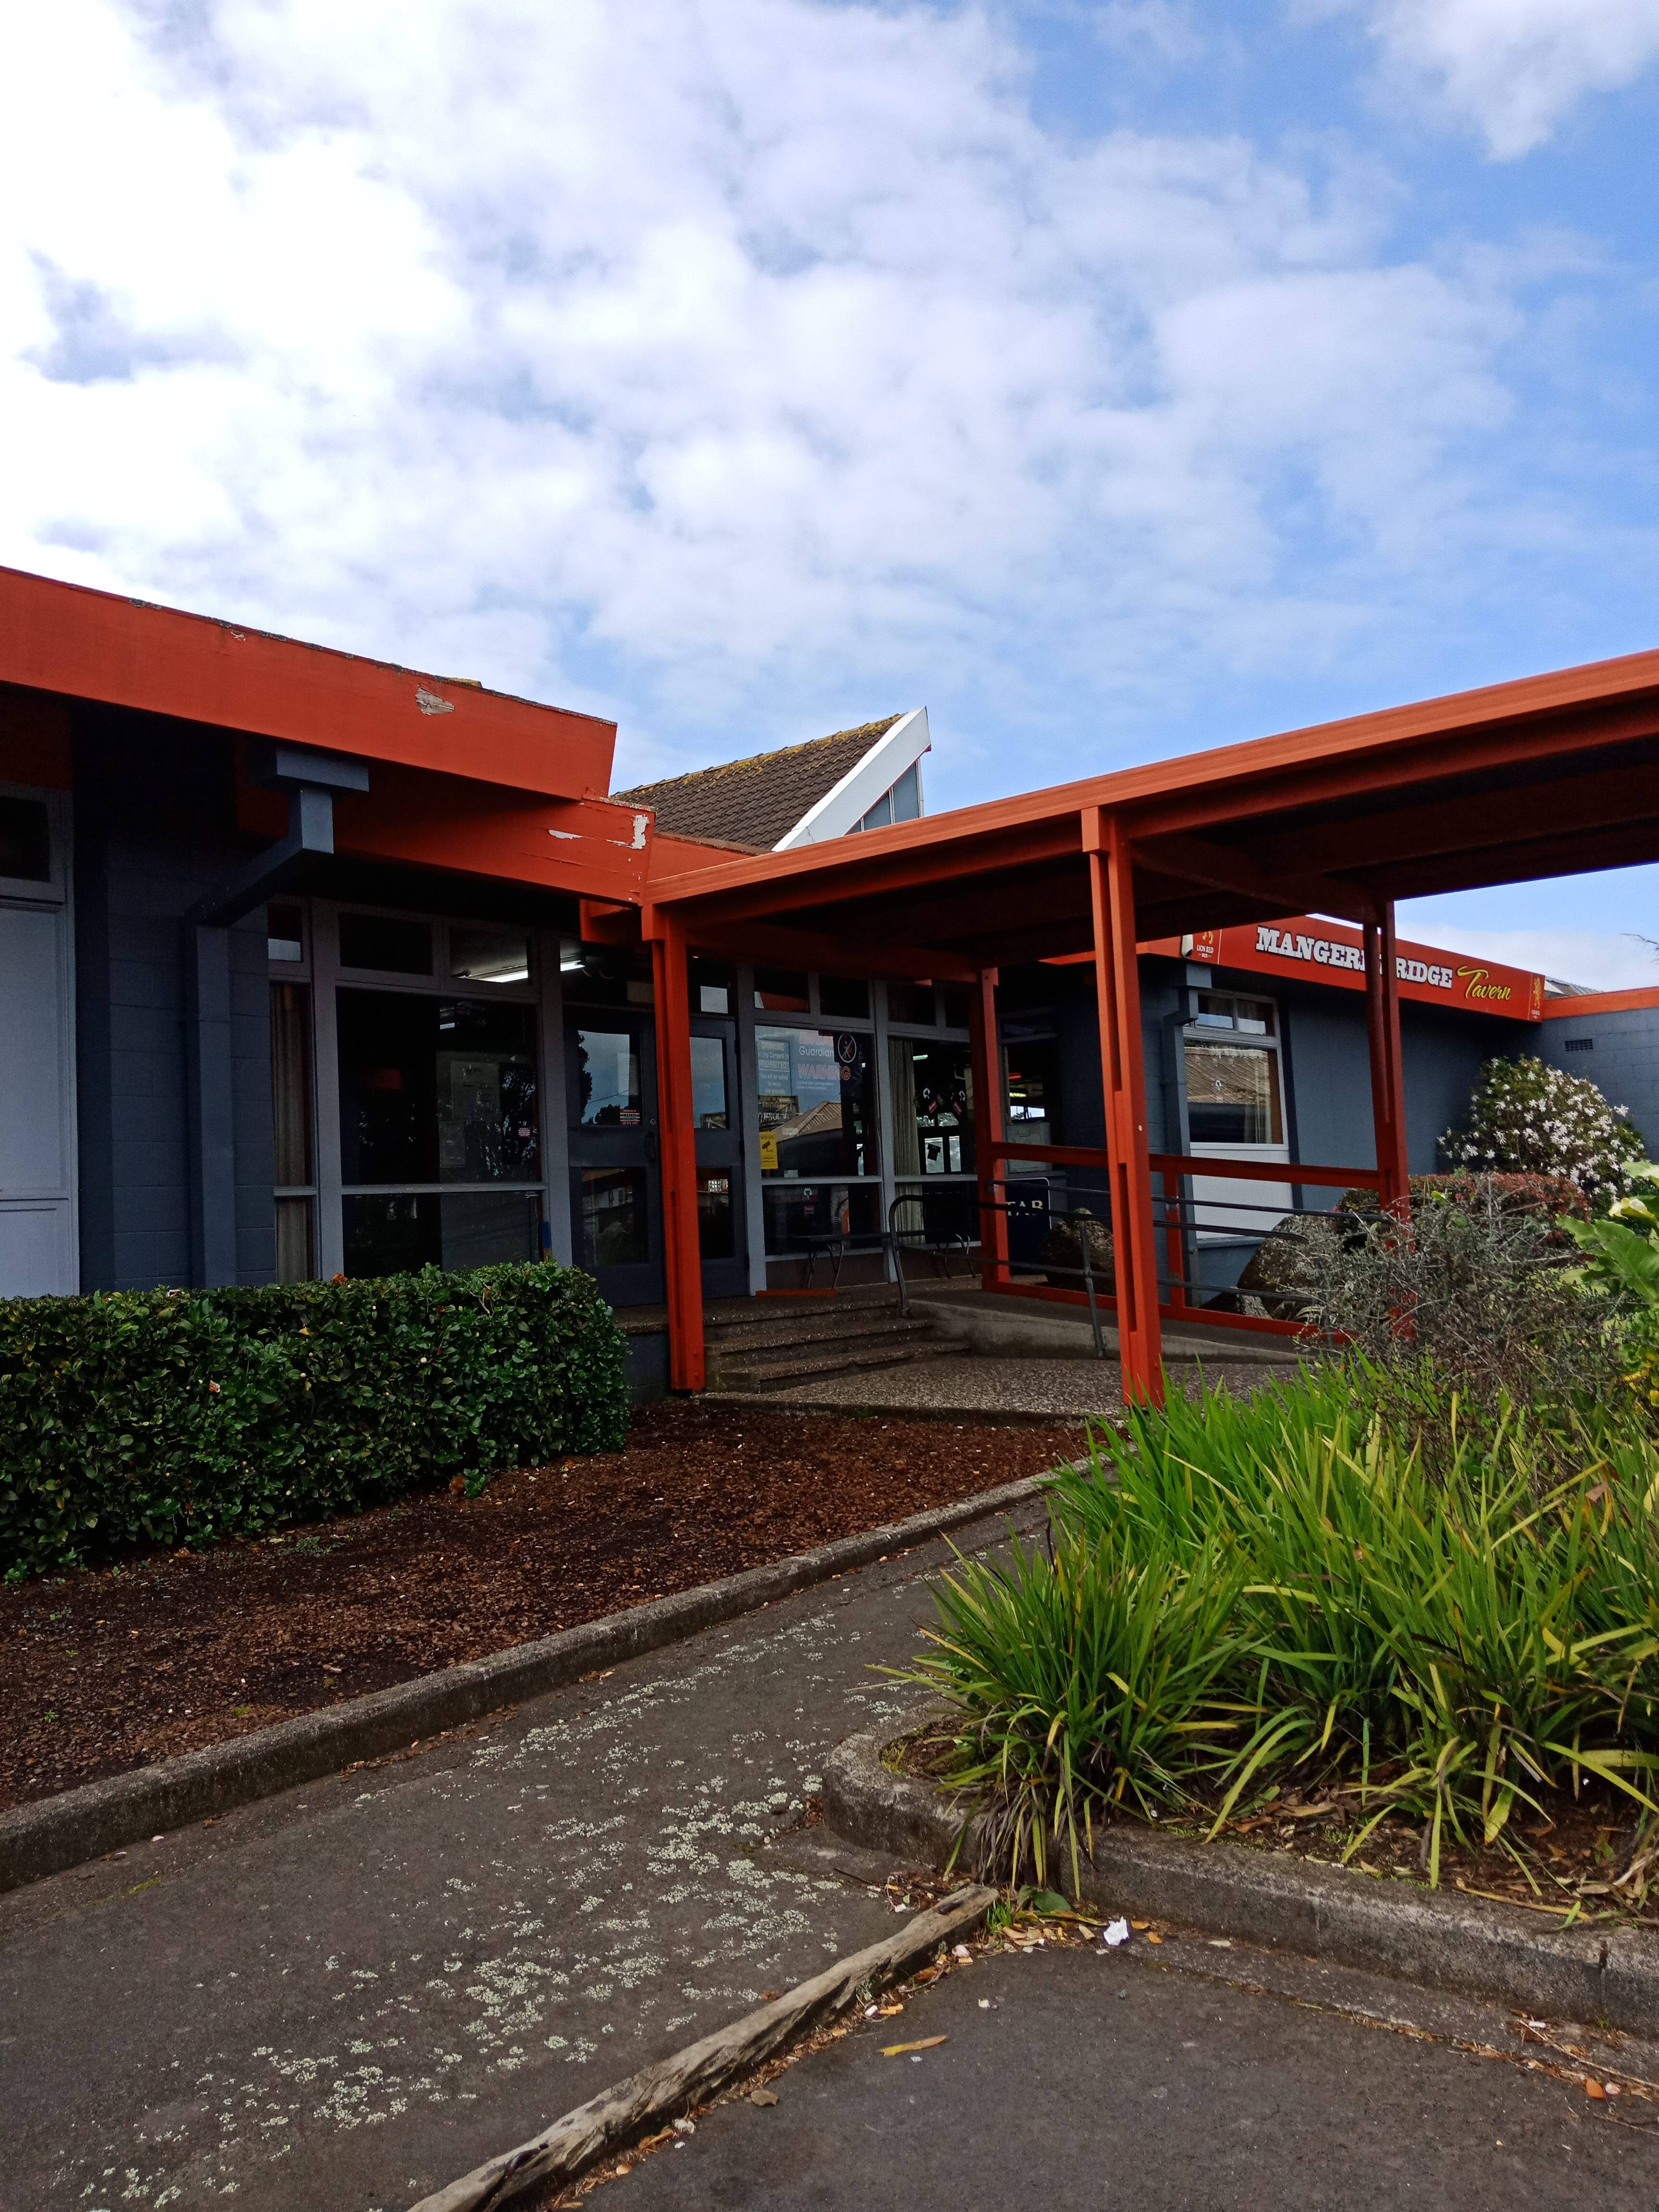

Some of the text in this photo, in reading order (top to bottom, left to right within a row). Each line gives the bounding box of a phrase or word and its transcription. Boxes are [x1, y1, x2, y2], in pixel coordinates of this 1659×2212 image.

[1197, 944, 1205, 952] LION
[1256, 926, 1511, 1000] MANGER RIDGE Tavern
[799, 1046, 834, 1057] Guardian
[797, 1063, 851, 1081] WARNING
